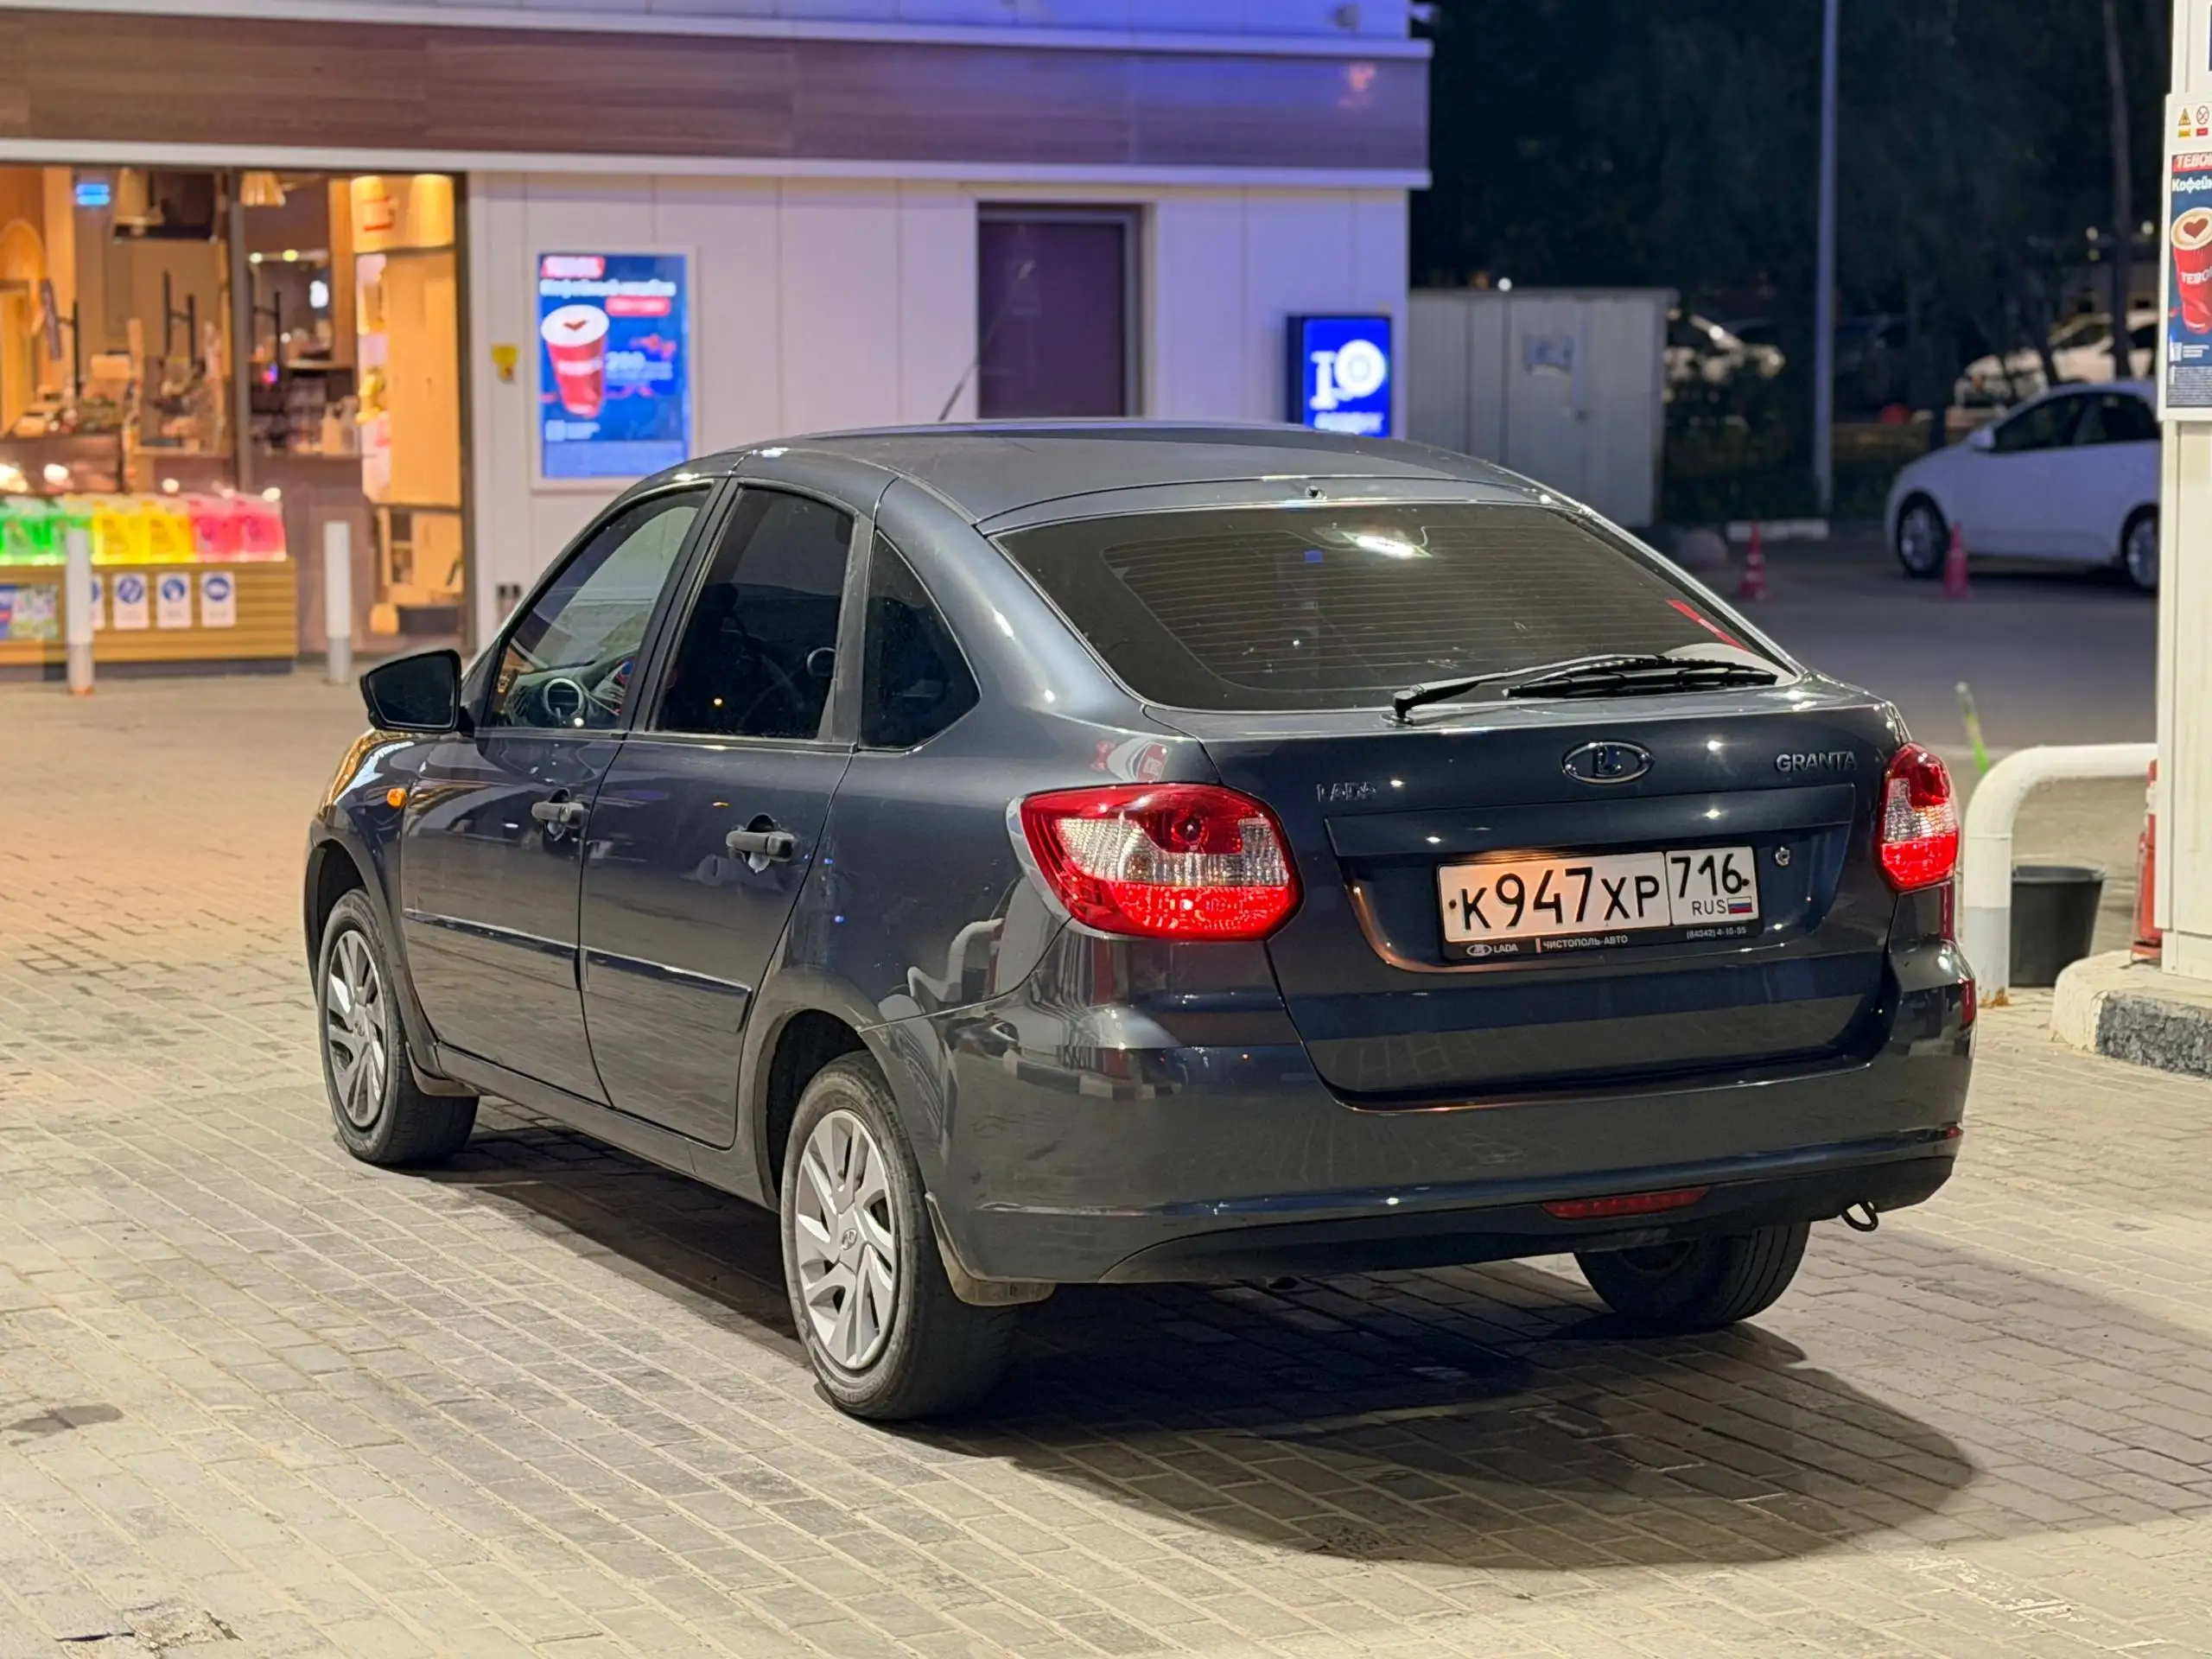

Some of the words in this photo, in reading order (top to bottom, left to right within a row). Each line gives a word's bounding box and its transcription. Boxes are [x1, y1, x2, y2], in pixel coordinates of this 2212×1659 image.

[1776, 751, 1857, 772] GRANTA
[1461, 867, 1660, 931] К947ХР
[1670, 853, 1742, 899] 716
[1692, 899, 1726, 915] RUS
[1493, 944, 1519, 954] LADA
[1542, 935, 1629, 950] ЧИСТОПОЛЬ-АВТО
